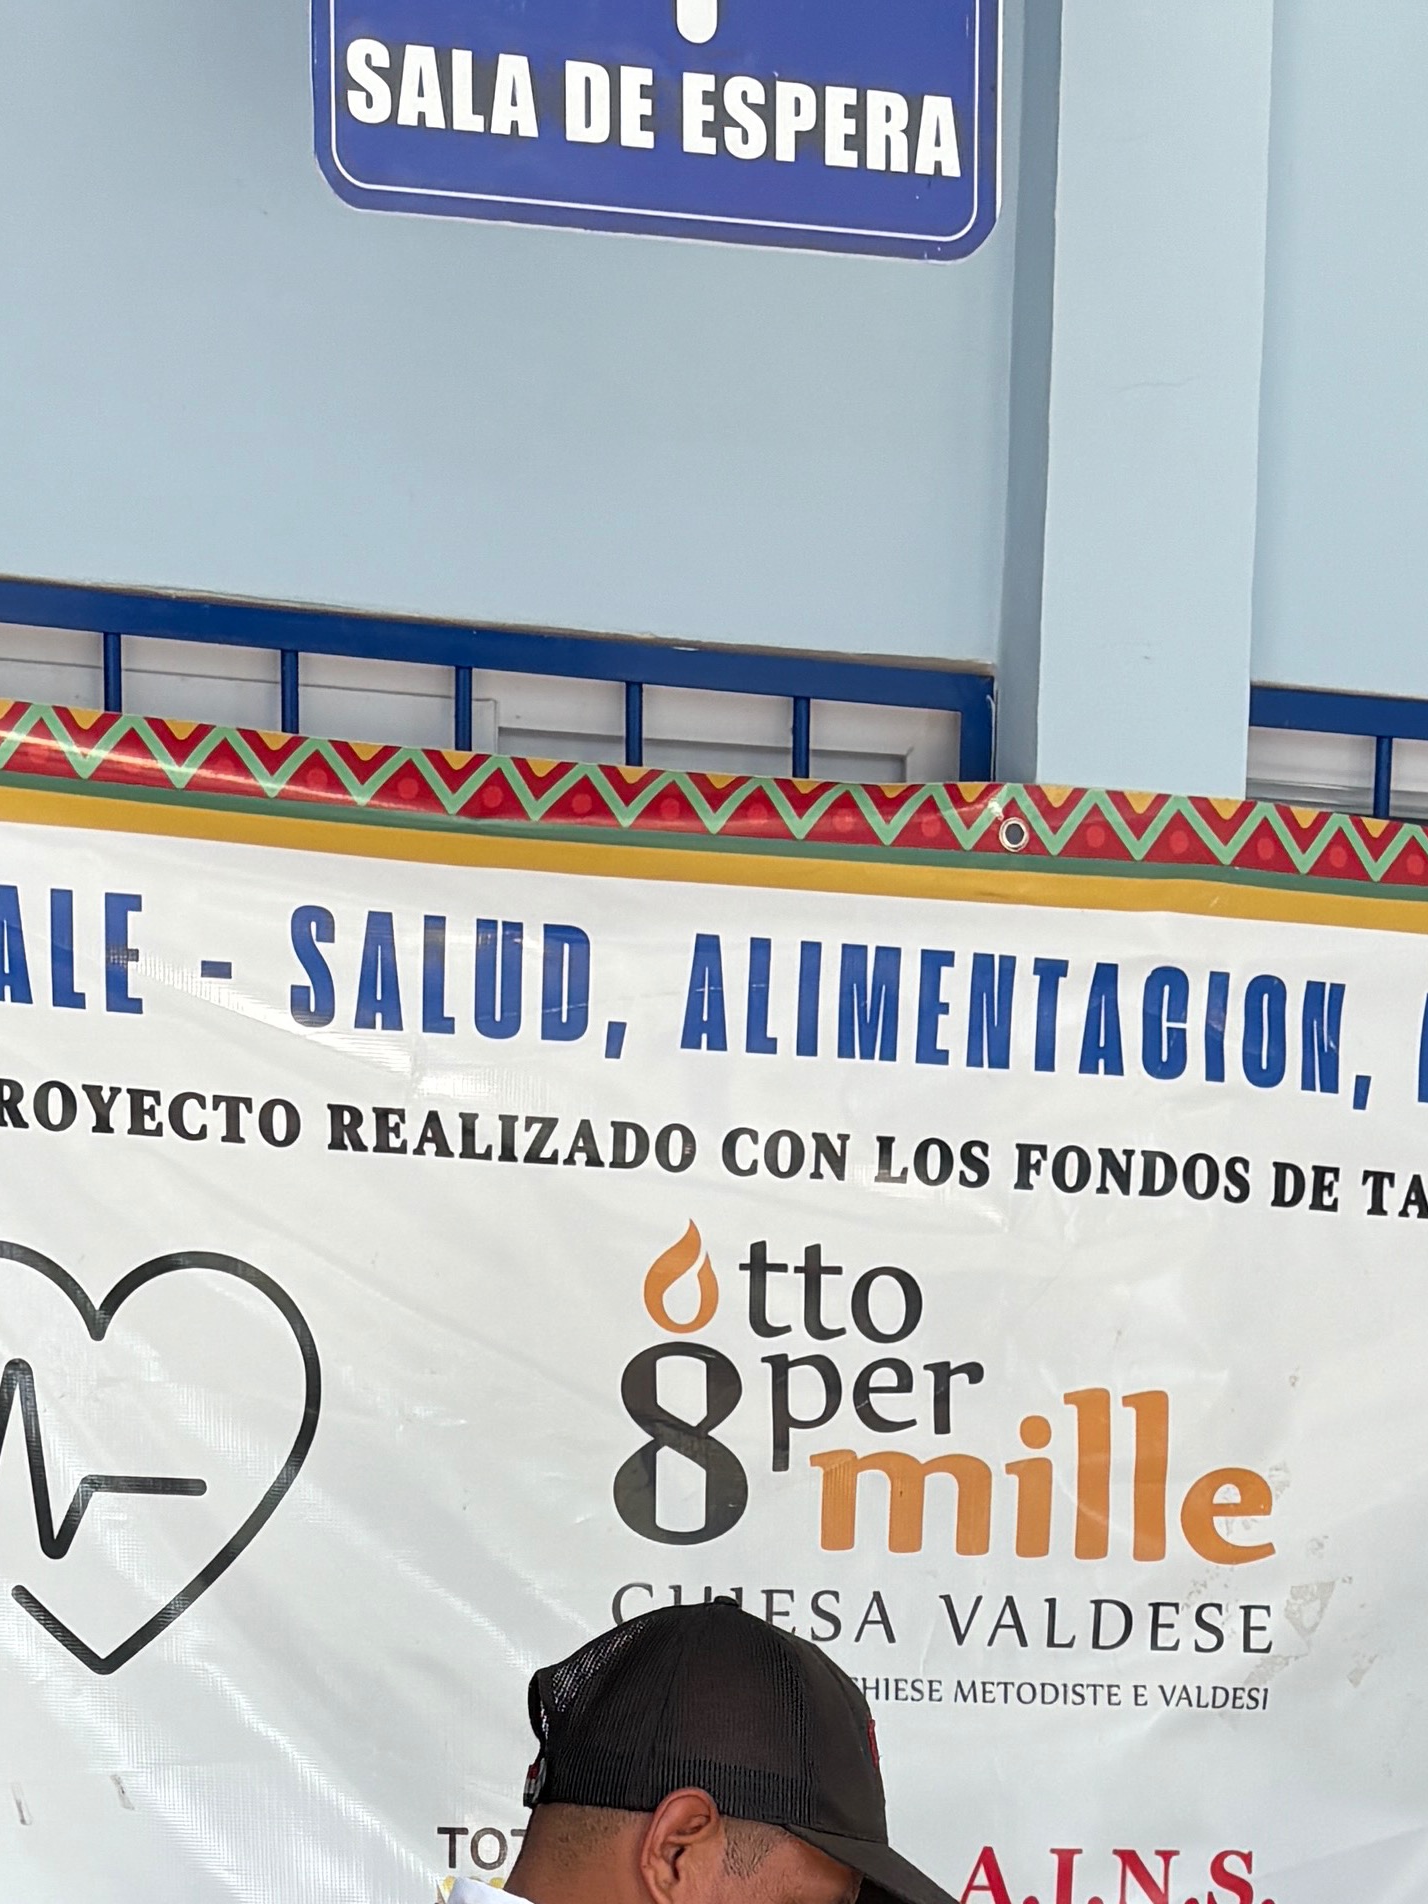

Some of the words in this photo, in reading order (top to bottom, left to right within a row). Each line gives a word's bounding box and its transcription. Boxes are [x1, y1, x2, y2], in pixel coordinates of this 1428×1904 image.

[346, 38, 539, 138] SALA
[565, 59, 655, 149] DE
[682, 71, 961, 178] ESPERA
[201, 960, 232, 978] -
[290, 905, 628, 1059] SALUD,
[680, 932, 1372, 1110] ALIMENTACION,
[326, 1103, 698, 1173] REALIZADO
[721, 1127, 852, 1181] CON
[874, 1135, 990, 1189] LOS
[1013, 1142, 1251, 1204] FONDOS
[1270, 1161, 1341, 1213] DE
[612, 1341, 750, 1546] 8
[761, 1353, 985, 1472] per
[809, 1387, 1277, 1565] mille
[938, 1593, 1274, 1655] VALDESE
[852, 1676, 944, 1703] HIESE
[953, 1679, 1122, 1706] METODISTE
[1132, 1684, 1148, 1707] E
[1158, 1684, 1270, 1711] VALDESI
[436, 1826, 527, 1871] TO
